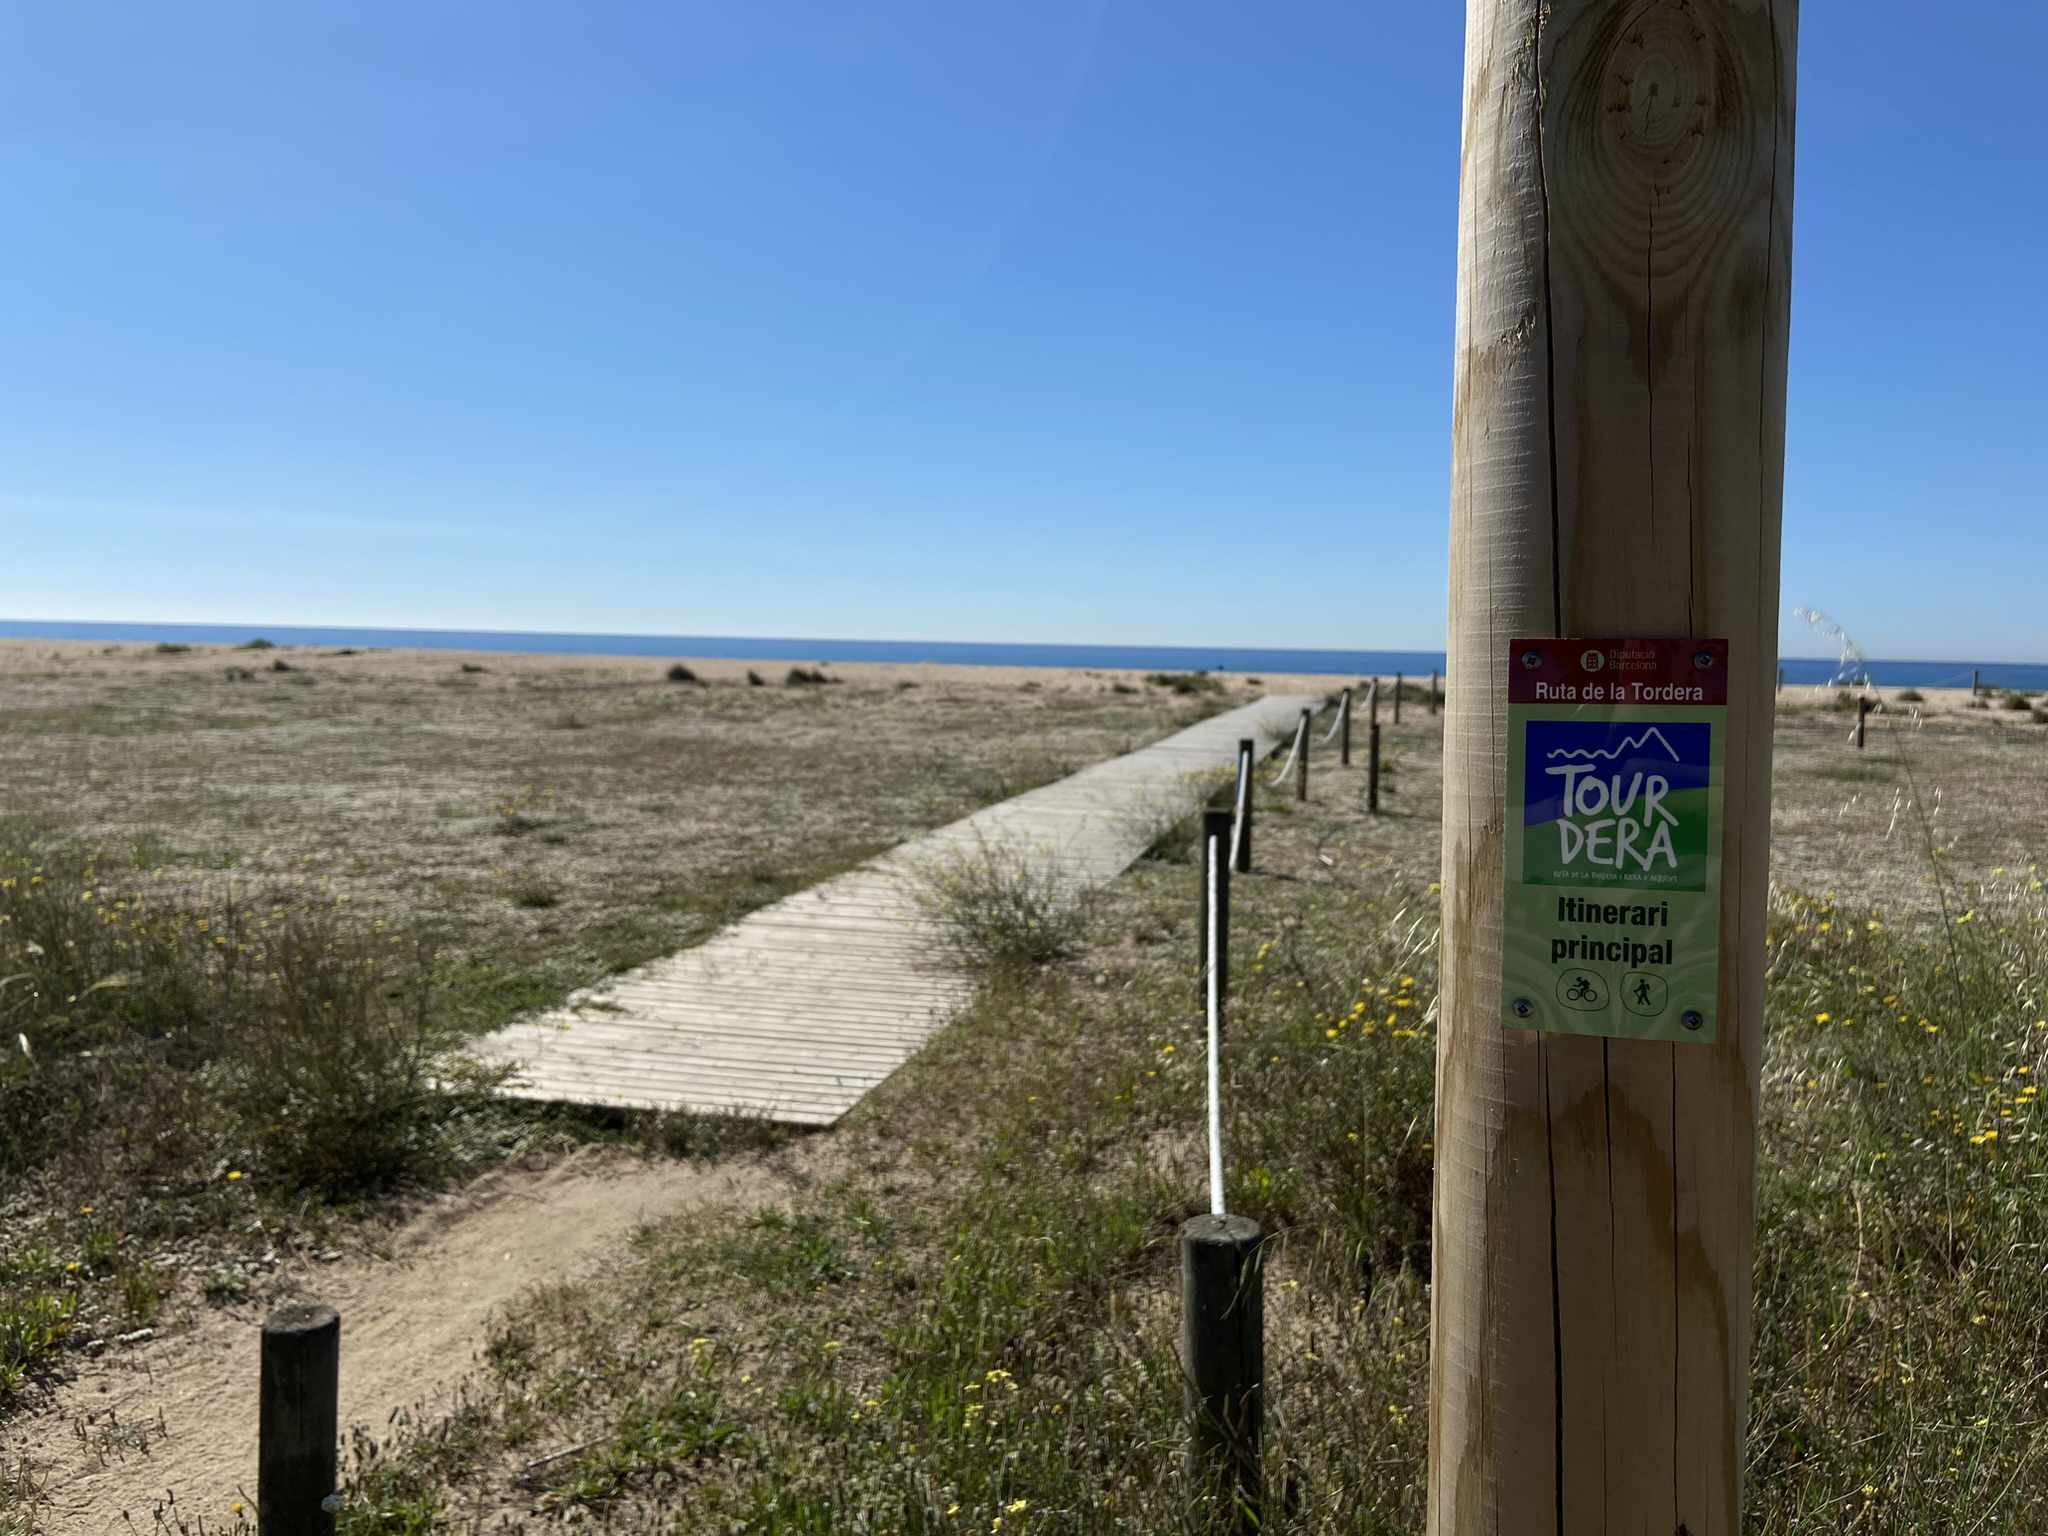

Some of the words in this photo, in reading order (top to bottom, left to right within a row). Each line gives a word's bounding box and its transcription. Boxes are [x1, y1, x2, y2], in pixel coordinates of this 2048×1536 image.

[1609, 649, 1655, 661] Diputació
[1609, 660, 1657, 670] Barcelona
[1535, 682, 1577, 700] Ruta
[1582, 683, 1604, 700] de
[1610, 683, 1625, 700] la
[1631, 682, 1703, 701] Tordera
[1545, 763, 1680, 828] TOUR
[1557, 817, 1678, 872] DERA
[1553, 870, 1569, 878] RUTA
[1571, 871, 1579, 879] DE
[1557, 896, 1668, 927] Itinerari
[1551, 934, 1673, 969] principal
